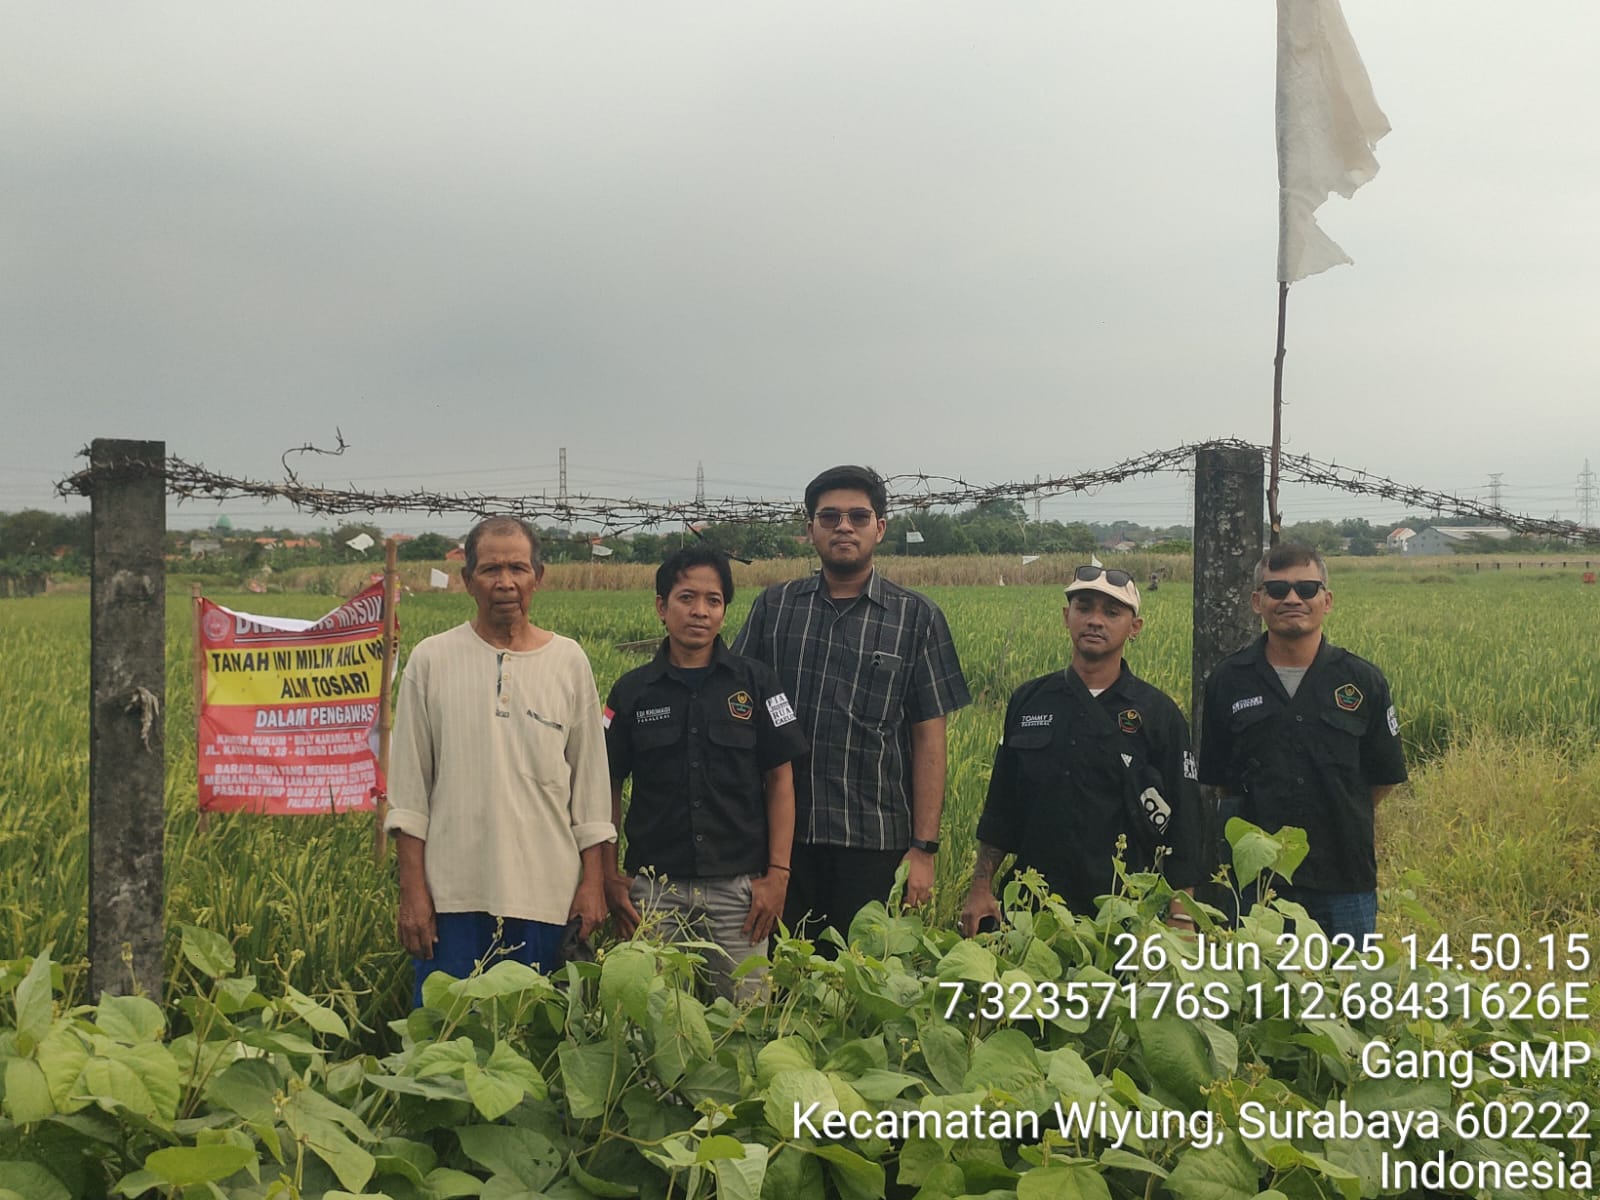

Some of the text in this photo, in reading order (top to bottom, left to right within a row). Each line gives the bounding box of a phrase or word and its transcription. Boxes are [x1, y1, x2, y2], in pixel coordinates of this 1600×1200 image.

[212, 652, 269, 672] TANAH
[273, 650, 291, 671] INI
[296, 647, 334, 670] MILIK
[337, 644, 366, 667] AHLI
[281, 671, 370, 699] ALM TOSARI
[256, 703, 375, 728] DALAM PENGAWAS
[1021, 714, 1048, 722] TOMMY
